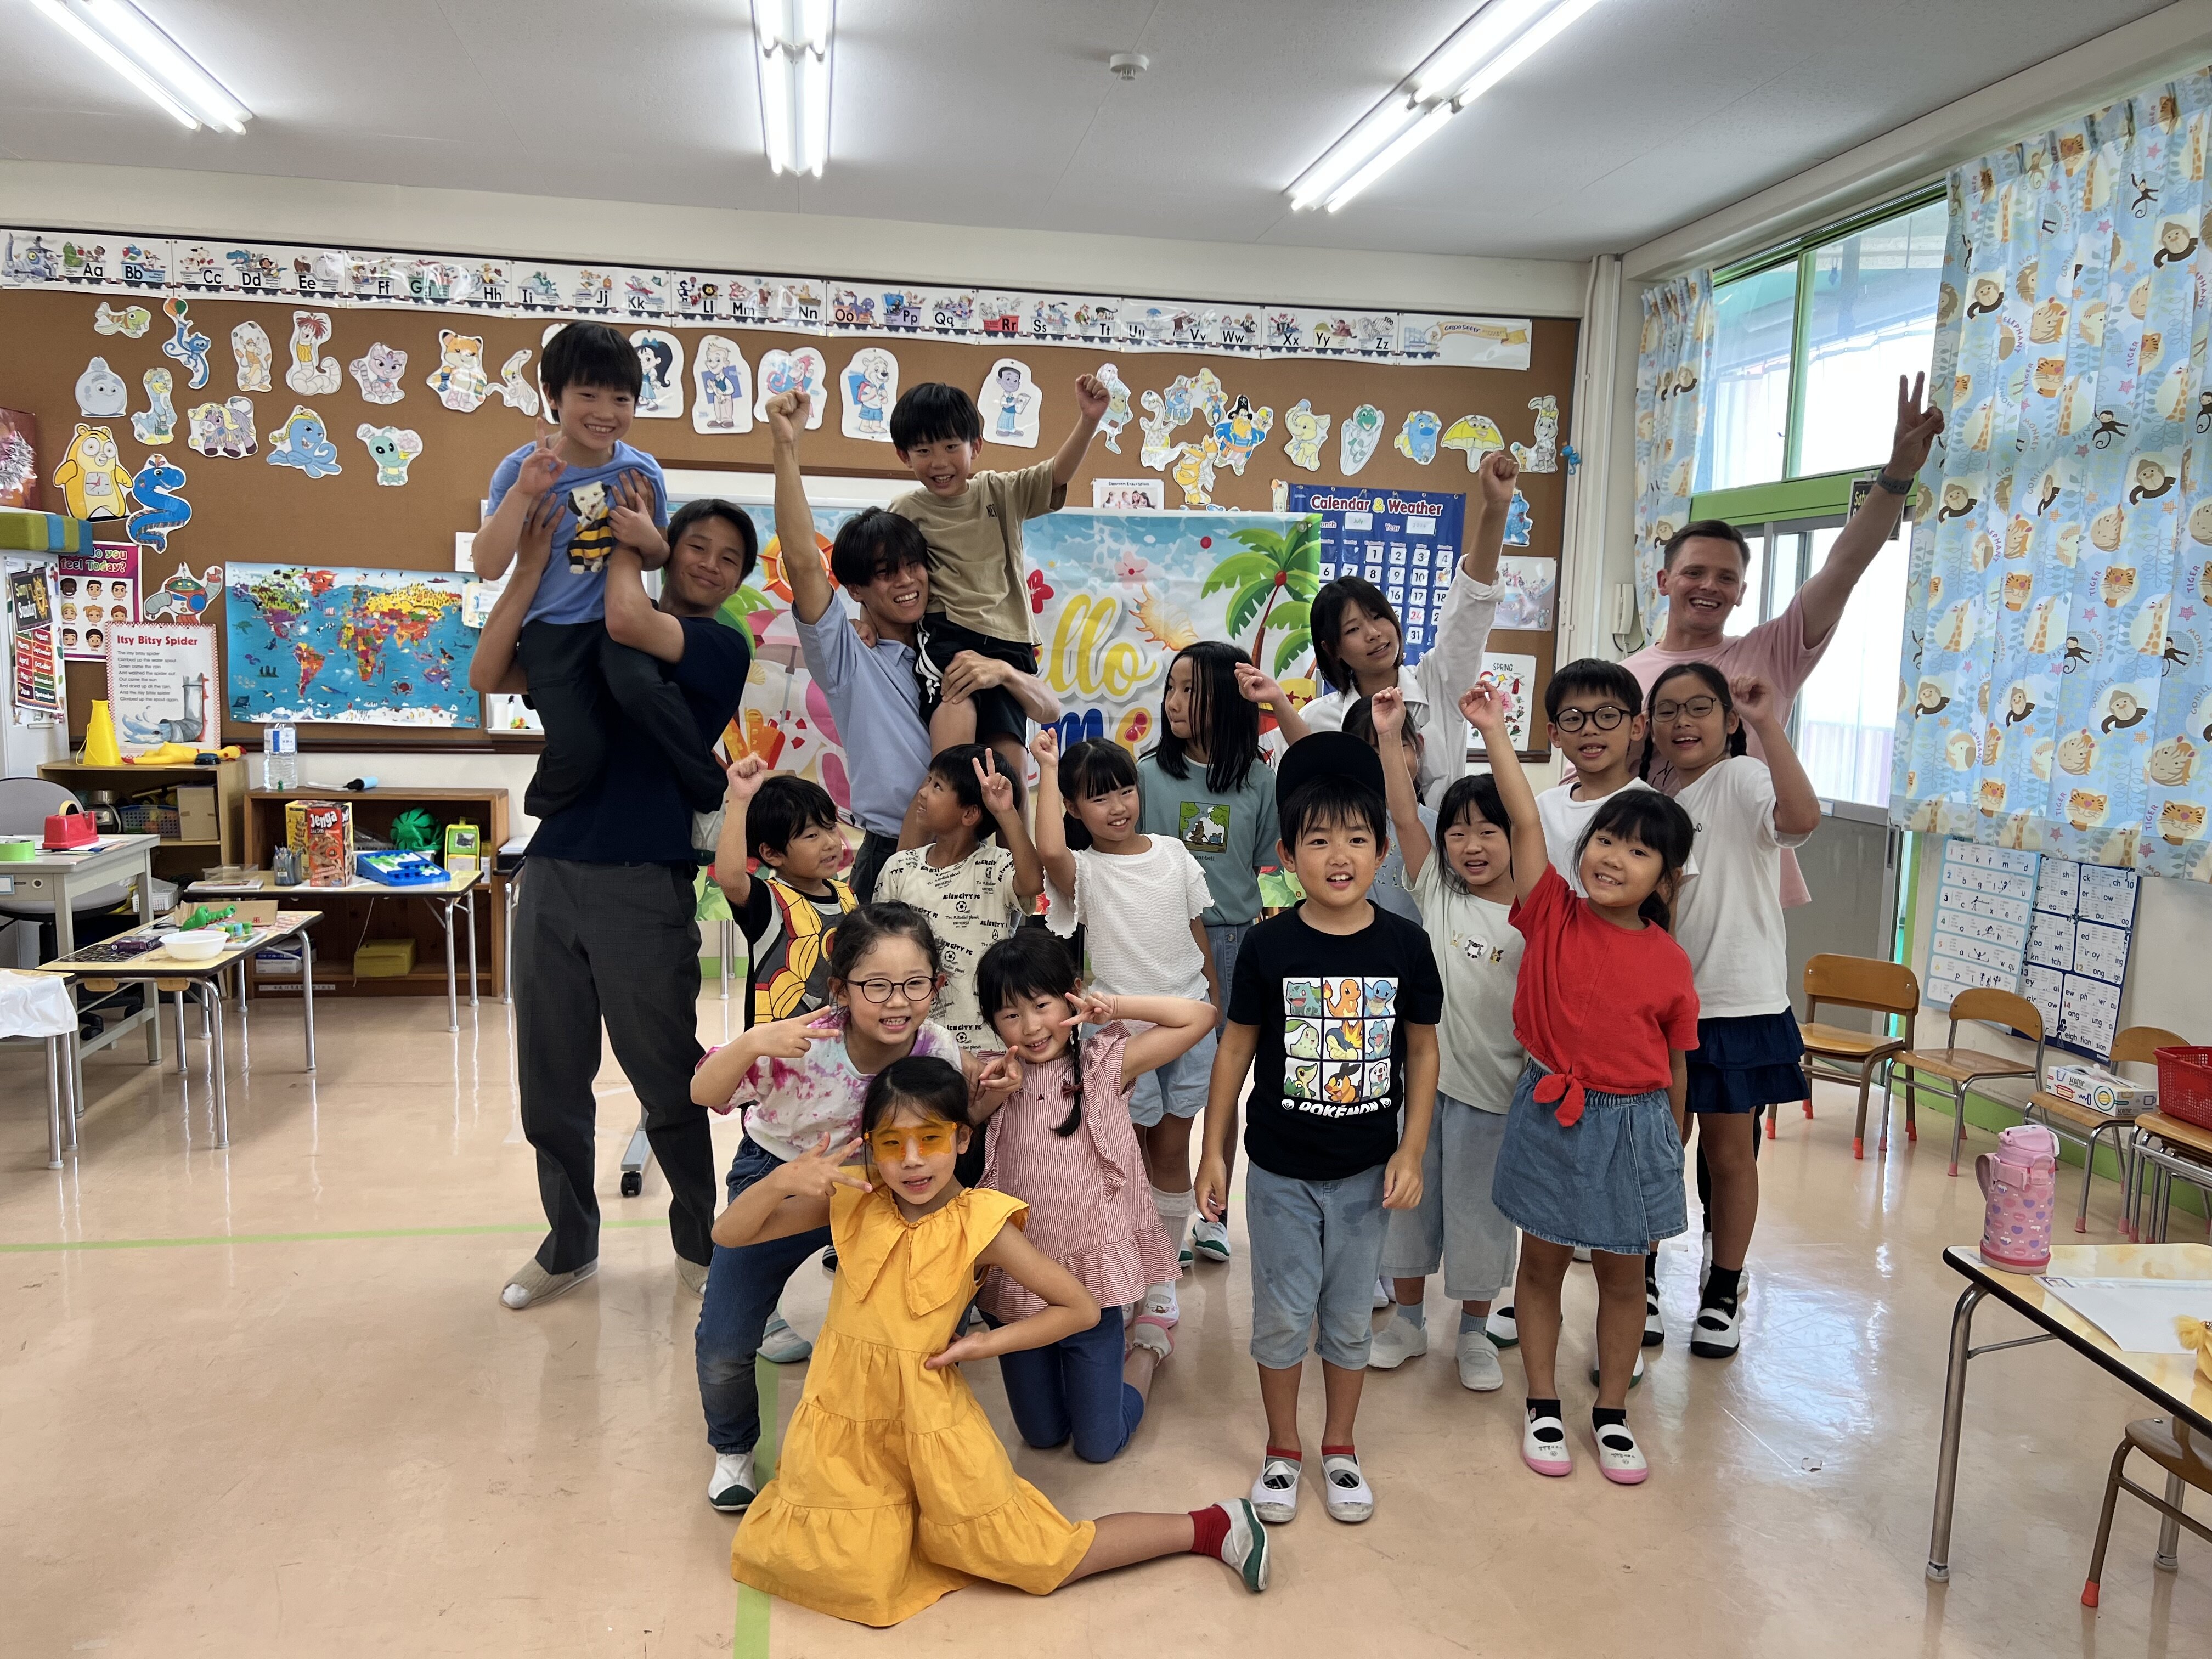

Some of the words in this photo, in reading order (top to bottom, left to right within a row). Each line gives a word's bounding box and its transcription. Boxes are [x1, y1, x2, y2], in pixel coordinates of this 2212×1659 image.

[83, 264, 103, 277] Aa
[125, 266, 143, 279] Bb
[204, 272, 222, 285] Cc
[242, 272, 261, 286] Dd
[299, 275, 316, 289] Ee
[379, 281, 390, 295] Ff
[411, 281, 432, 297] Gg
[484, 287, 502, 301] Hh
[522, 289, 533, 303] Ii
[596, 290, 608, 307] Jj
[628, 296, 645, 309] Kk
[704, 301, 713, 313] Ll
[733, 304, 754, 317] Mm
[800, 306, 817, 319] Nn
[835, 308, 854, 322] Oo
[904, 309, 918, 326] Pp
[935, 314, 953, 328] Qq
[1002, 318, 1017, 331] Rr
[1034, 319, 1046, 332] Ss
[1100, 323, 1110, 336] Tt
[1129, 325, 1145, 337] Uu
[1190, 329, 1206, 341] Vv
[1223, 331, 1244, 343] Ww
[1283, 333, 1299, 346] Xx
[1317, 332, 1330, 347] Yy
[1376, 338, 1389, 350] Zz
[1311, 495, 1370, 511] Calendar
[1373, 498, 1385, 512] &
[1388, 499, 1443, 515] Weather
[1385, 523, 1400, 532] Year
[105, 550, 127, 559] you
[1373, 550, 1376, 558] 1
[1395, 552, 1401, 560] 2
[61, 559, 83, 570] feel
[86, 560, 126, 573] Today?
[1370, 570, 1376, 578] 8
[1394, 572, 1399, 580] 9
[1415, 573, 1424, 582] 10
[2187, 565, 2200, 593] TIGER
[2089, 570, 2101, 596] TIGER
[1391, 591, 1400, 599] 16
[1437, 594, 1446, 602] 18
[1411, 612, 1421, 620] 24
[117, 635, 134, 645] Itsy
[138, 636, 162, 646] Bitsy
[166, 636, 198, 646] Spider
[1411, 631, 1420, 640] 31
[1043, 594, 1156, 696] llo
[2187, 628, 2204, 667] MONKEY
[1493, 663, 1513, 672] SPRING
[2056, 792, 2067, 816] TIGER
[310, 811, 338, 828] Jenga
[2145, 805, 2159, 831] TIGER
[2092, 952, 2100, 960] oy
[2051, 958, 2061, 966] tch
[2008, 963, 2015, 972] qu
[2076, 963, 2083, 972] 12
[2026, 979, 2034, 987] ey
[2068, 1011, 2080, 1020] ang
[2092, 1018, 2102, 1028] ung
[2065, 1032, 2077, 1042] eigh
[2080, 1036, 2091, 1046] tion
